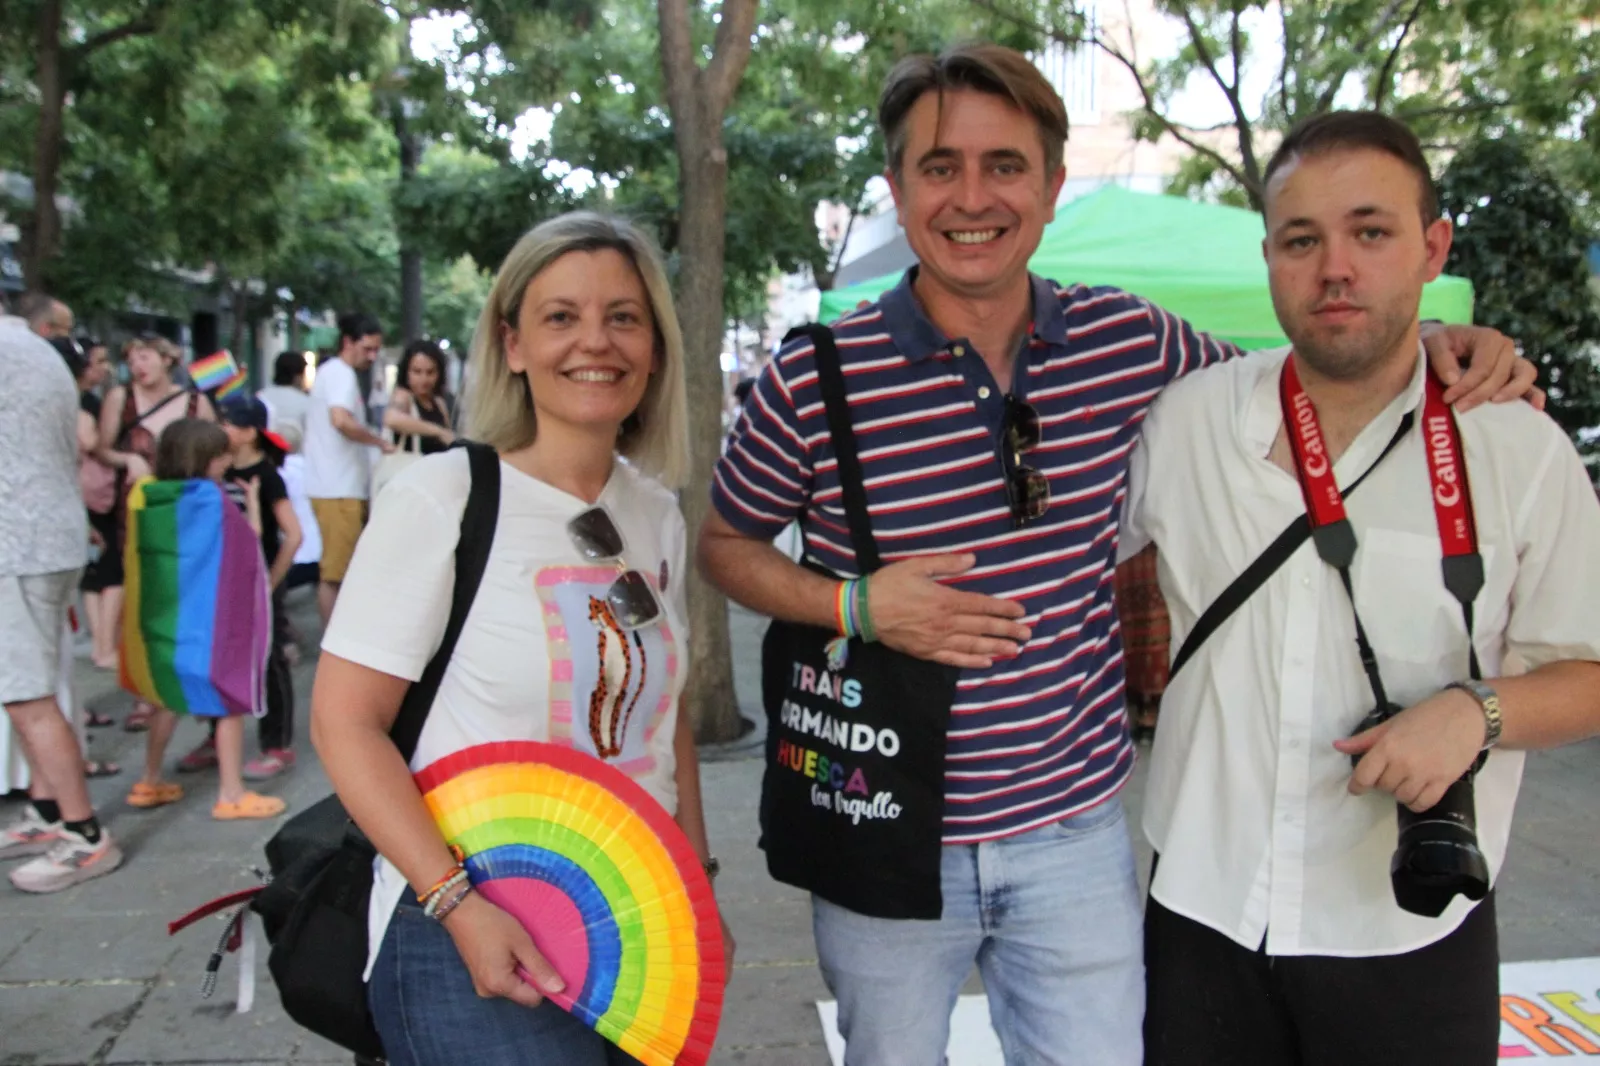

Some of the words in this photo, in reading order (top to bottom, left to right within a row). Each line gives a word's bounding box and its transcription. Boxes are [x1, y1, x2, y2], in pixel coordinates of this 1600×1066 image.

[1293, 391, 1328, 478] Canon
[1428, 415, 1460, 507] Canon
[792, 661, 863, 708] TRANS
[777, 738, 870, 797] HUESCA
